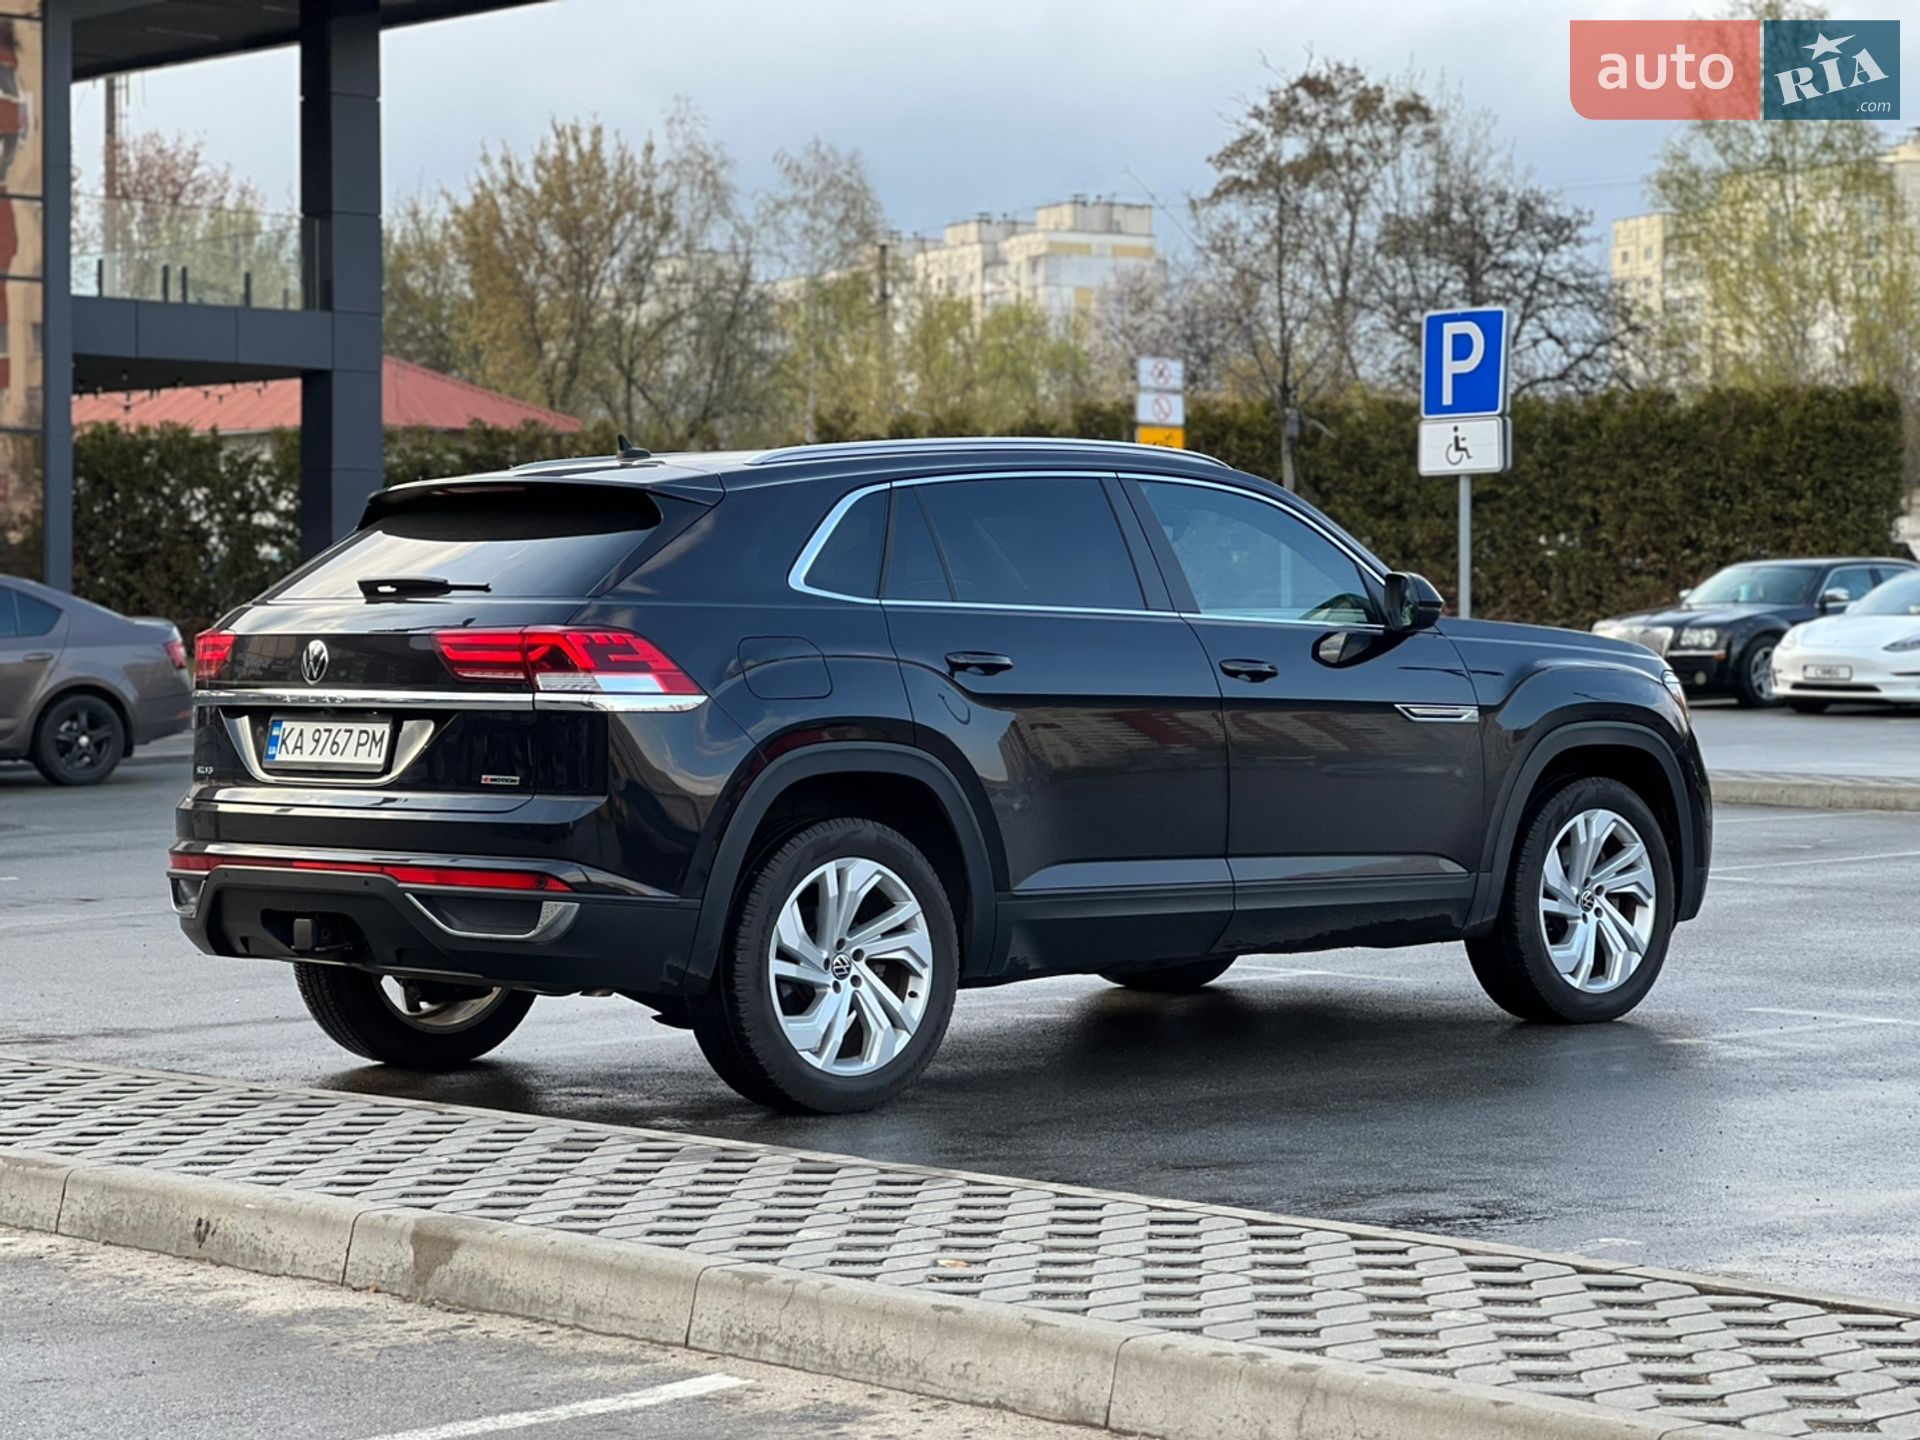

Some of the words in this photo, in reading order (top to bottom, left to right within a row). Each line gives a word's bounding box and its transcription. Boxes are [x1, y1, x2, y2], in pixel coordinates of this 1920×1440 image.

[1442, 321, 1485, 406] P
[278, 727, 304, 756] KA
[308, 728, 354, 757] 9767
[353, 729, 386, 758] PM
